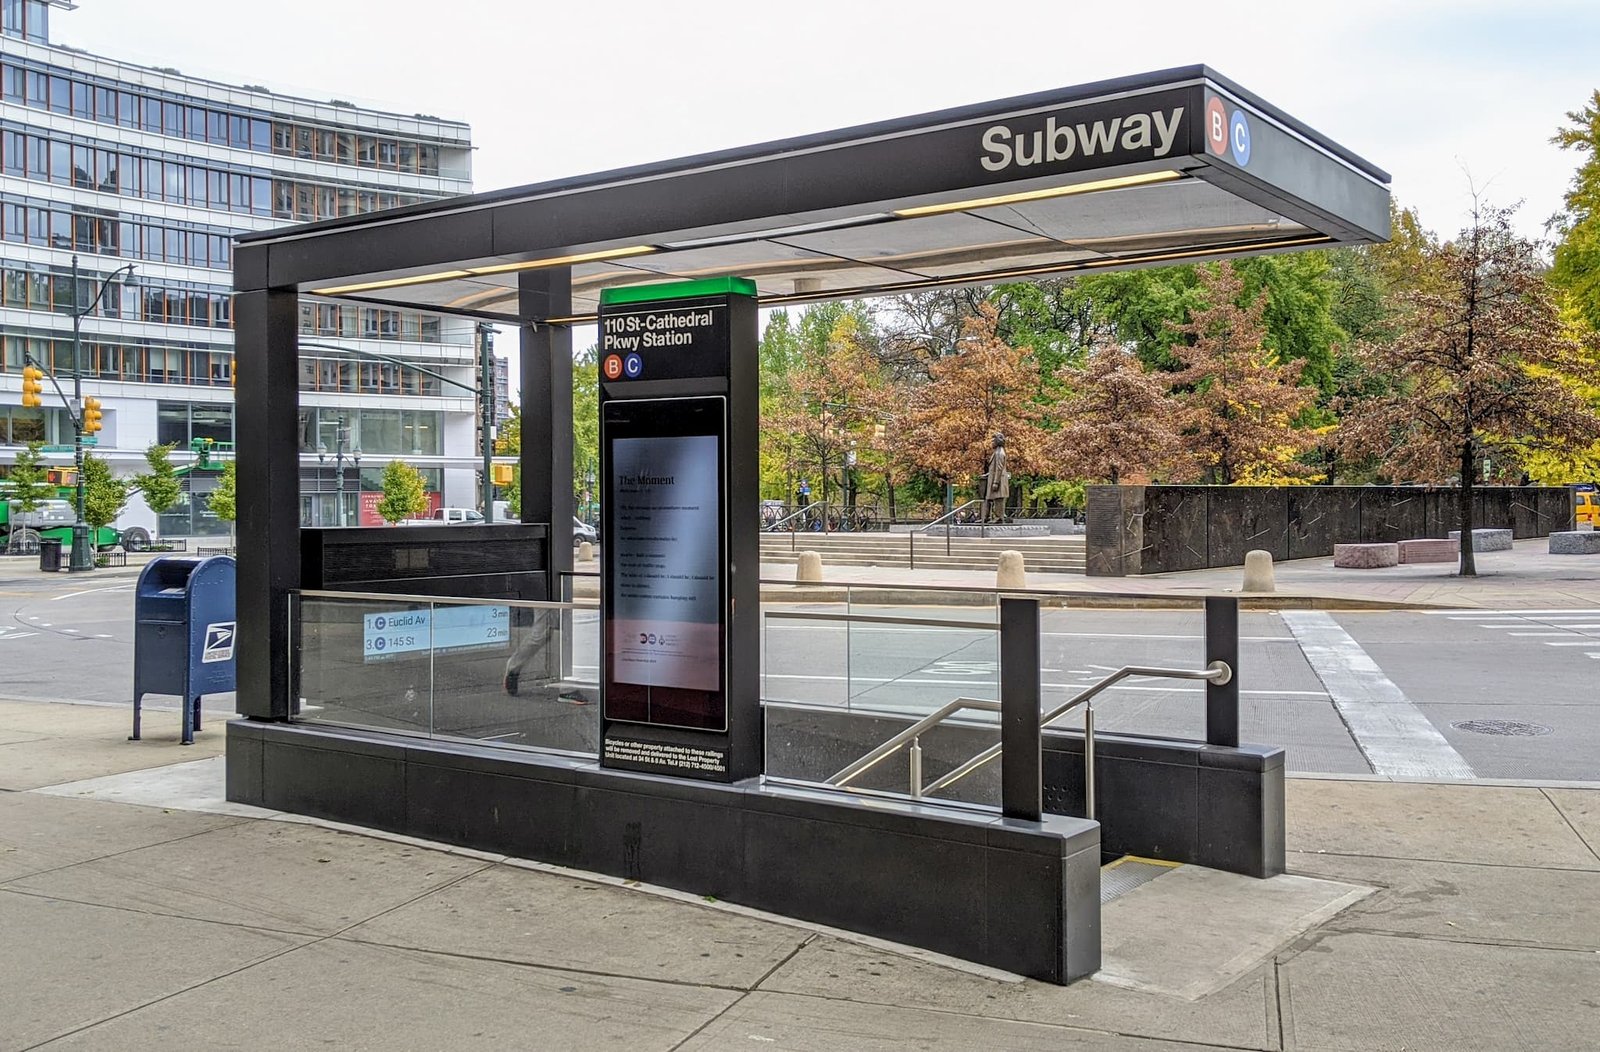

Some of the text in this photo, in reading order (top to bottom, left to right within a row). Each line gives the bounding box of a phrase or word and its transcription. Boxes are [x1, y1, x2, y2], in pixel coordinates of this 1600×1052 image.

[1211, 110, 1246, 152] B C
[980, 106, 1185, 172] Subway
[604, 310, 713, 334] 110 St-Cathedral
[604, 330, 693, 351] Pkwy Station
[637, 475, 675, 485] Moment
[492, 608, 498, 618] 3
[367, 619, 375, 630] 1.
[388, 615, 414, 627] Euclid
[414, 615, 426, 625] Av
[486, 627, 498, 638] 23
[366, 639, 375, 650] 3.
[388, 637, 405, 648] 145
[405, 636, 415, 646] St
[605, 738, 625, 746] Bicycles
[643, 744, 664, 752] property
[664, 746, 685, 754] attached
[691, 748, 705, 756] these
[698, 756, 720, 765] Property
